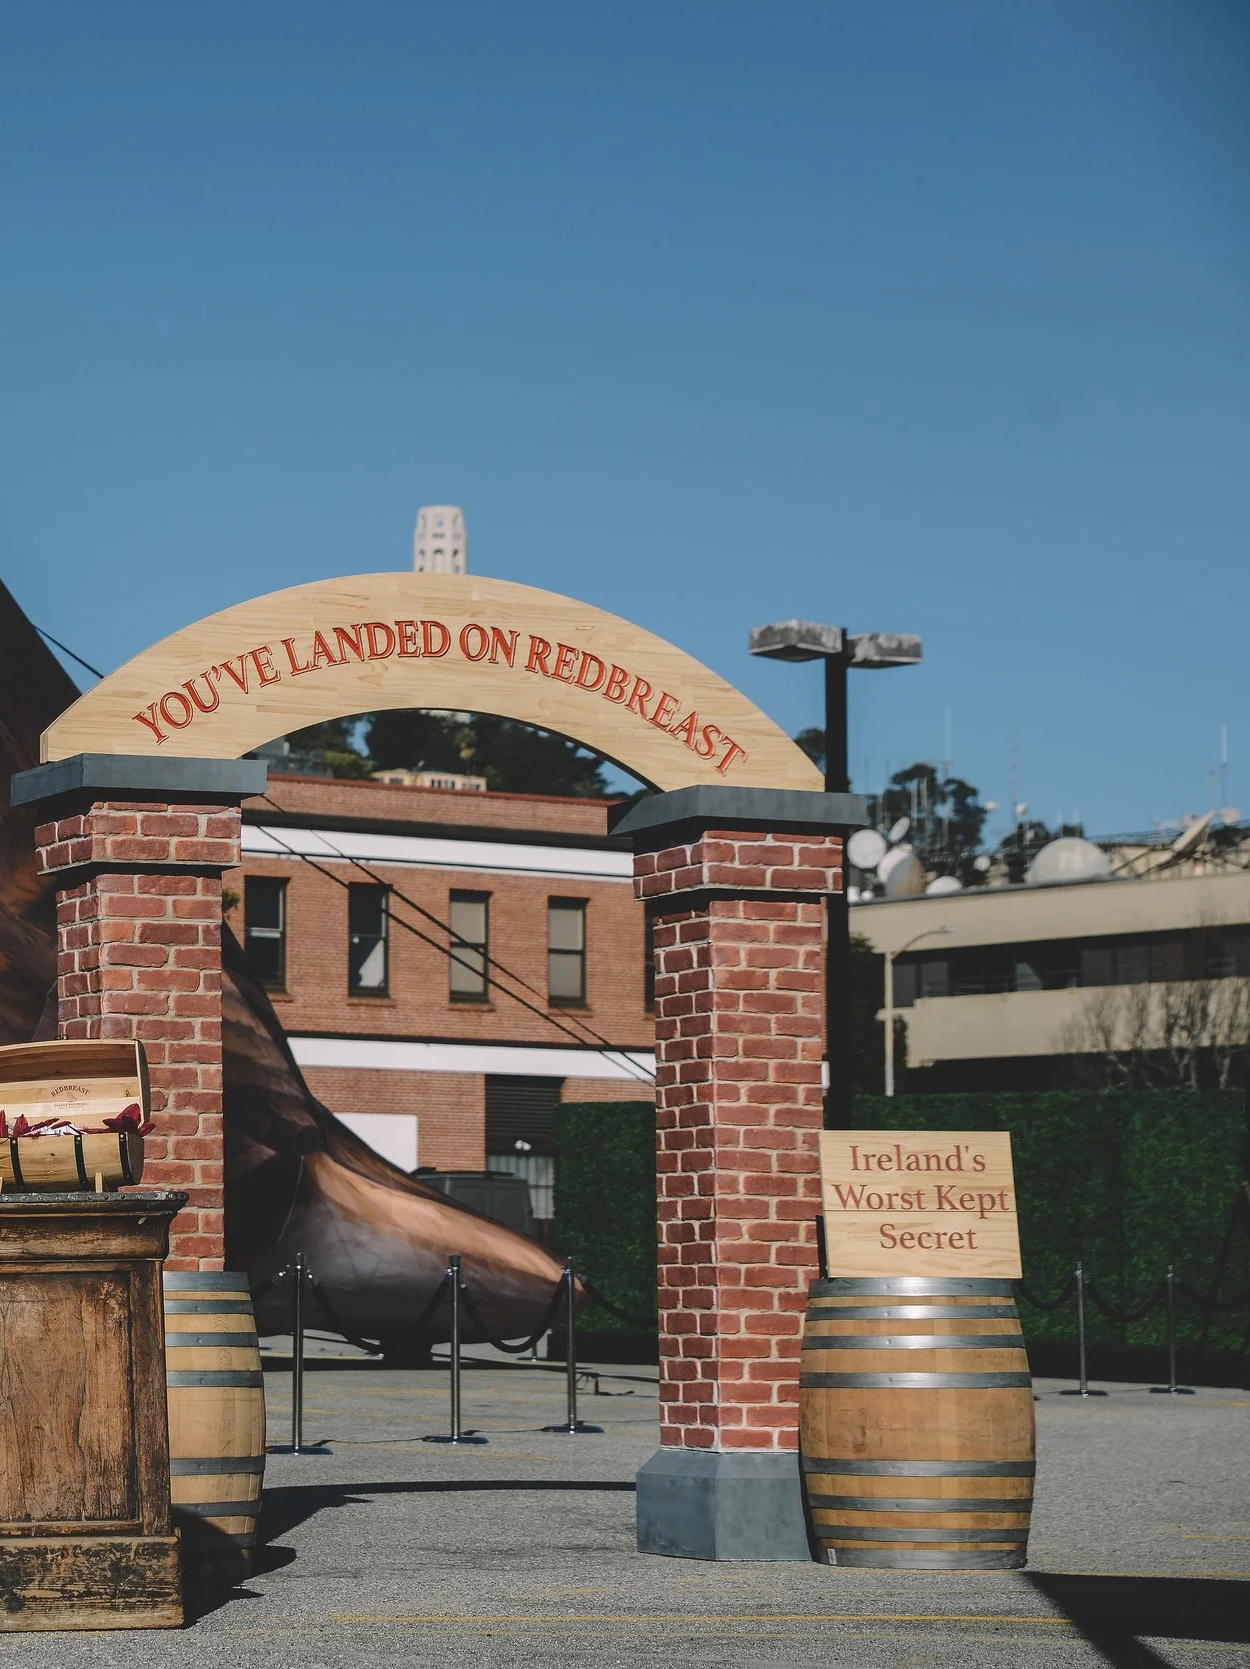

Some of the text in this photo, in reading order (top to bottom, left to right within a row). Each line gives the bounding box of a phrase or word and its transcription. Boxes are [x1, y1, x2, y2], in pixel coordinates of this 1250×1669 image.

[132, 620, 748, 777] YOU'VE LANDED ON REDBREAST
[50, 1085, 89, 1097] REDBREAST
[849, 1144, 986, 1172] Ireland's
[831, 1184, 1010, 1220] Worst Kept
[880, 1223, 979, 1250] Secret
